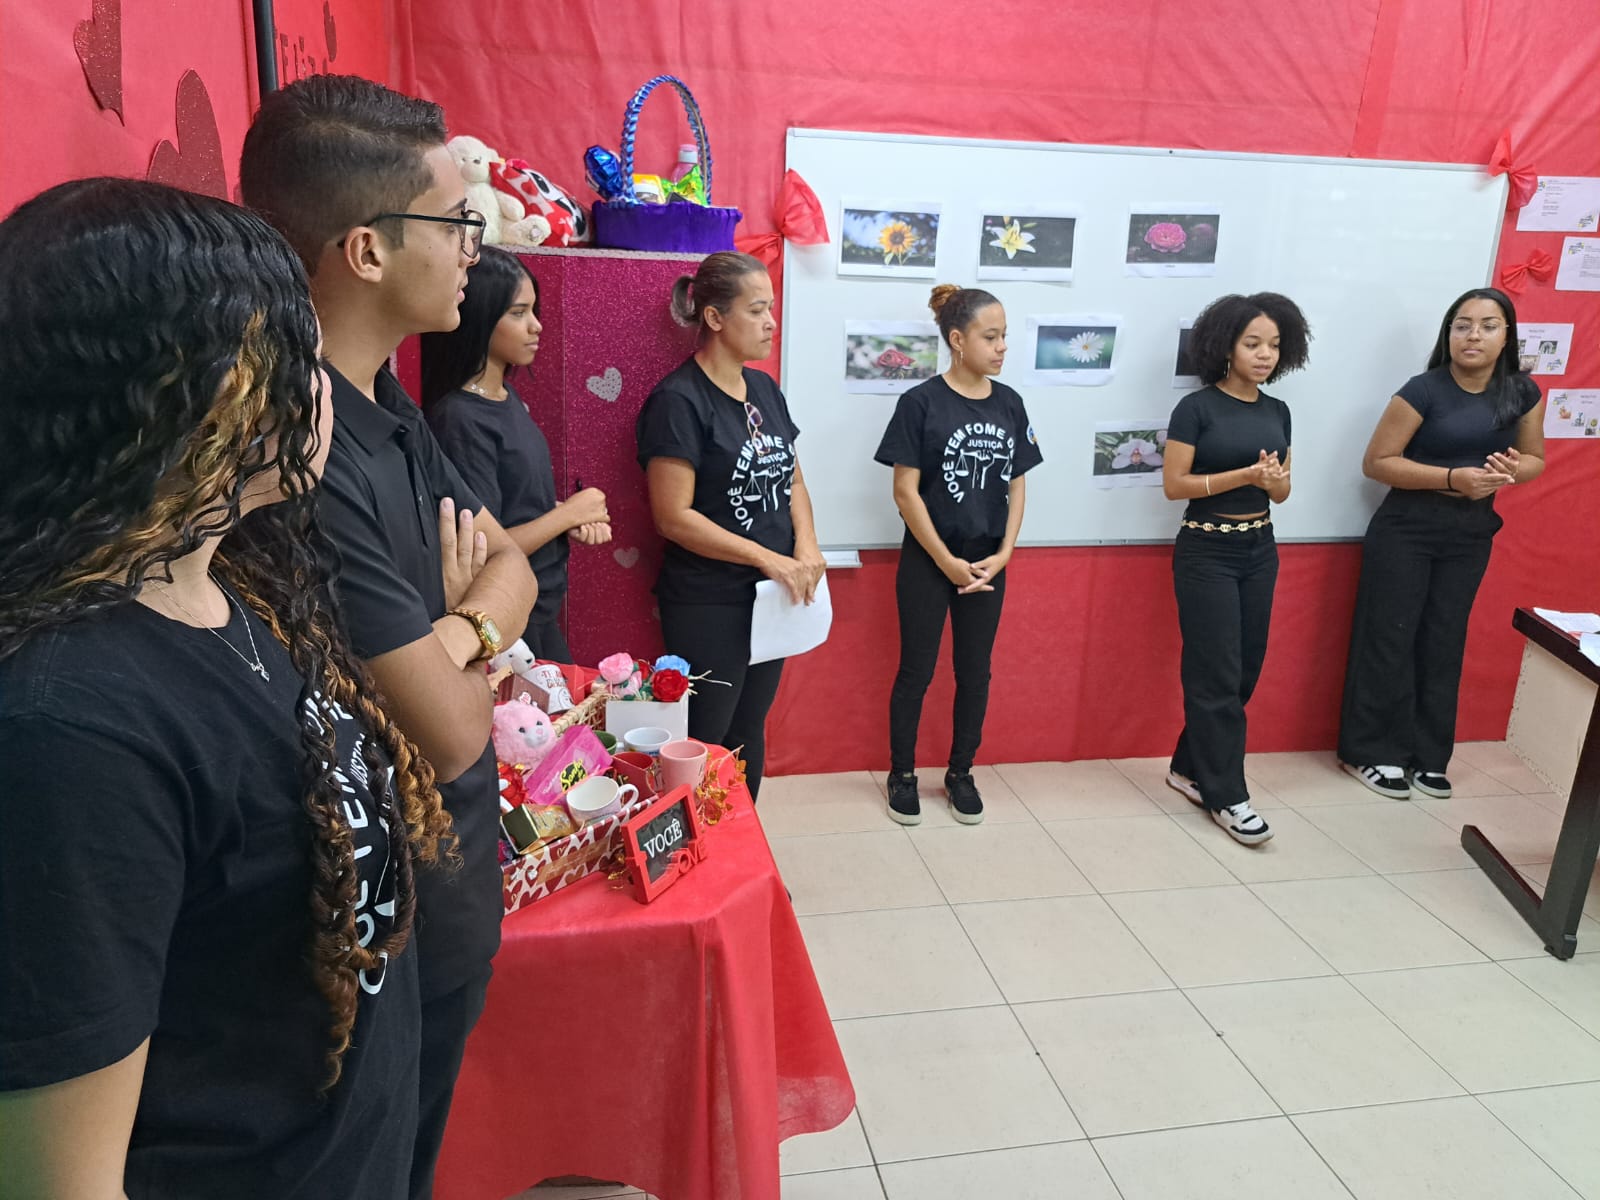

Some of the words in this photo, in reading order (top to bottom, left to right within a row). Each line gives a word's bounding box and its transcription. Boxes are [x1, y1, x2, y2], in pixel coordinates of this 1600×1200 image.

[944, 429, 967, 456] TEM
[965, 423, 1006, 439] FOME
[967, 439, 1003, 450] JUSTIÇA
[732, 445, 755, 480] TEM
[942, 461, 965, 503] VOCÊ
[727, 486, 753, 531] VOCÊ
[643, 818, 683, 858] VOCÊ
